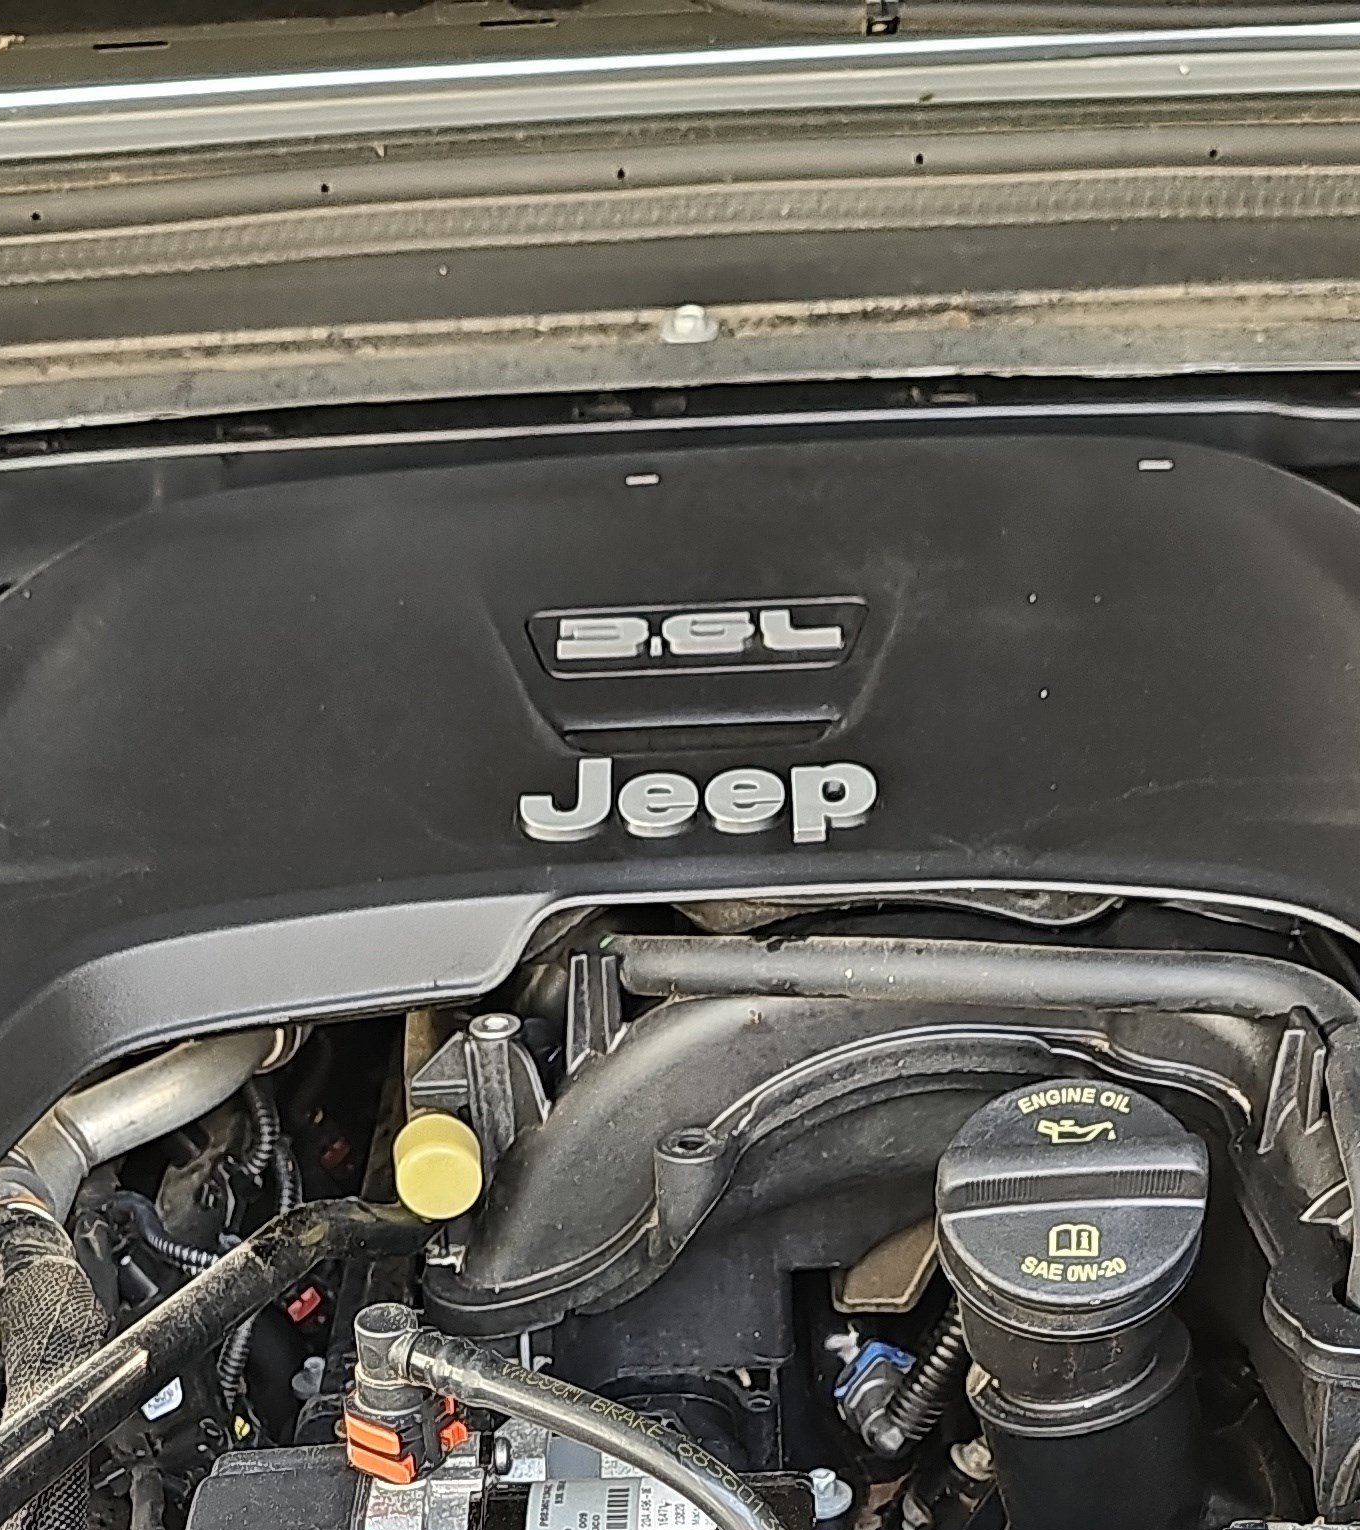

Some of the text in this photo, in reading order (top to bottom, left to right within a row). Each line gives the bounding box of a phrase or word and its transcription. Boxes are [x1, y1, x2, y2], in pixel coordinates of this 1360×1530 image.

[556, 609, 843, 661] 3.6L
[519, 757, 878, 843] Jeep
[1018, 1086, 1131, 1115] ENGINE OIL
[1020, 1256, 1128, 1283] SAE 0W-20
[589, 1397, 665, 1441] BRAKE
